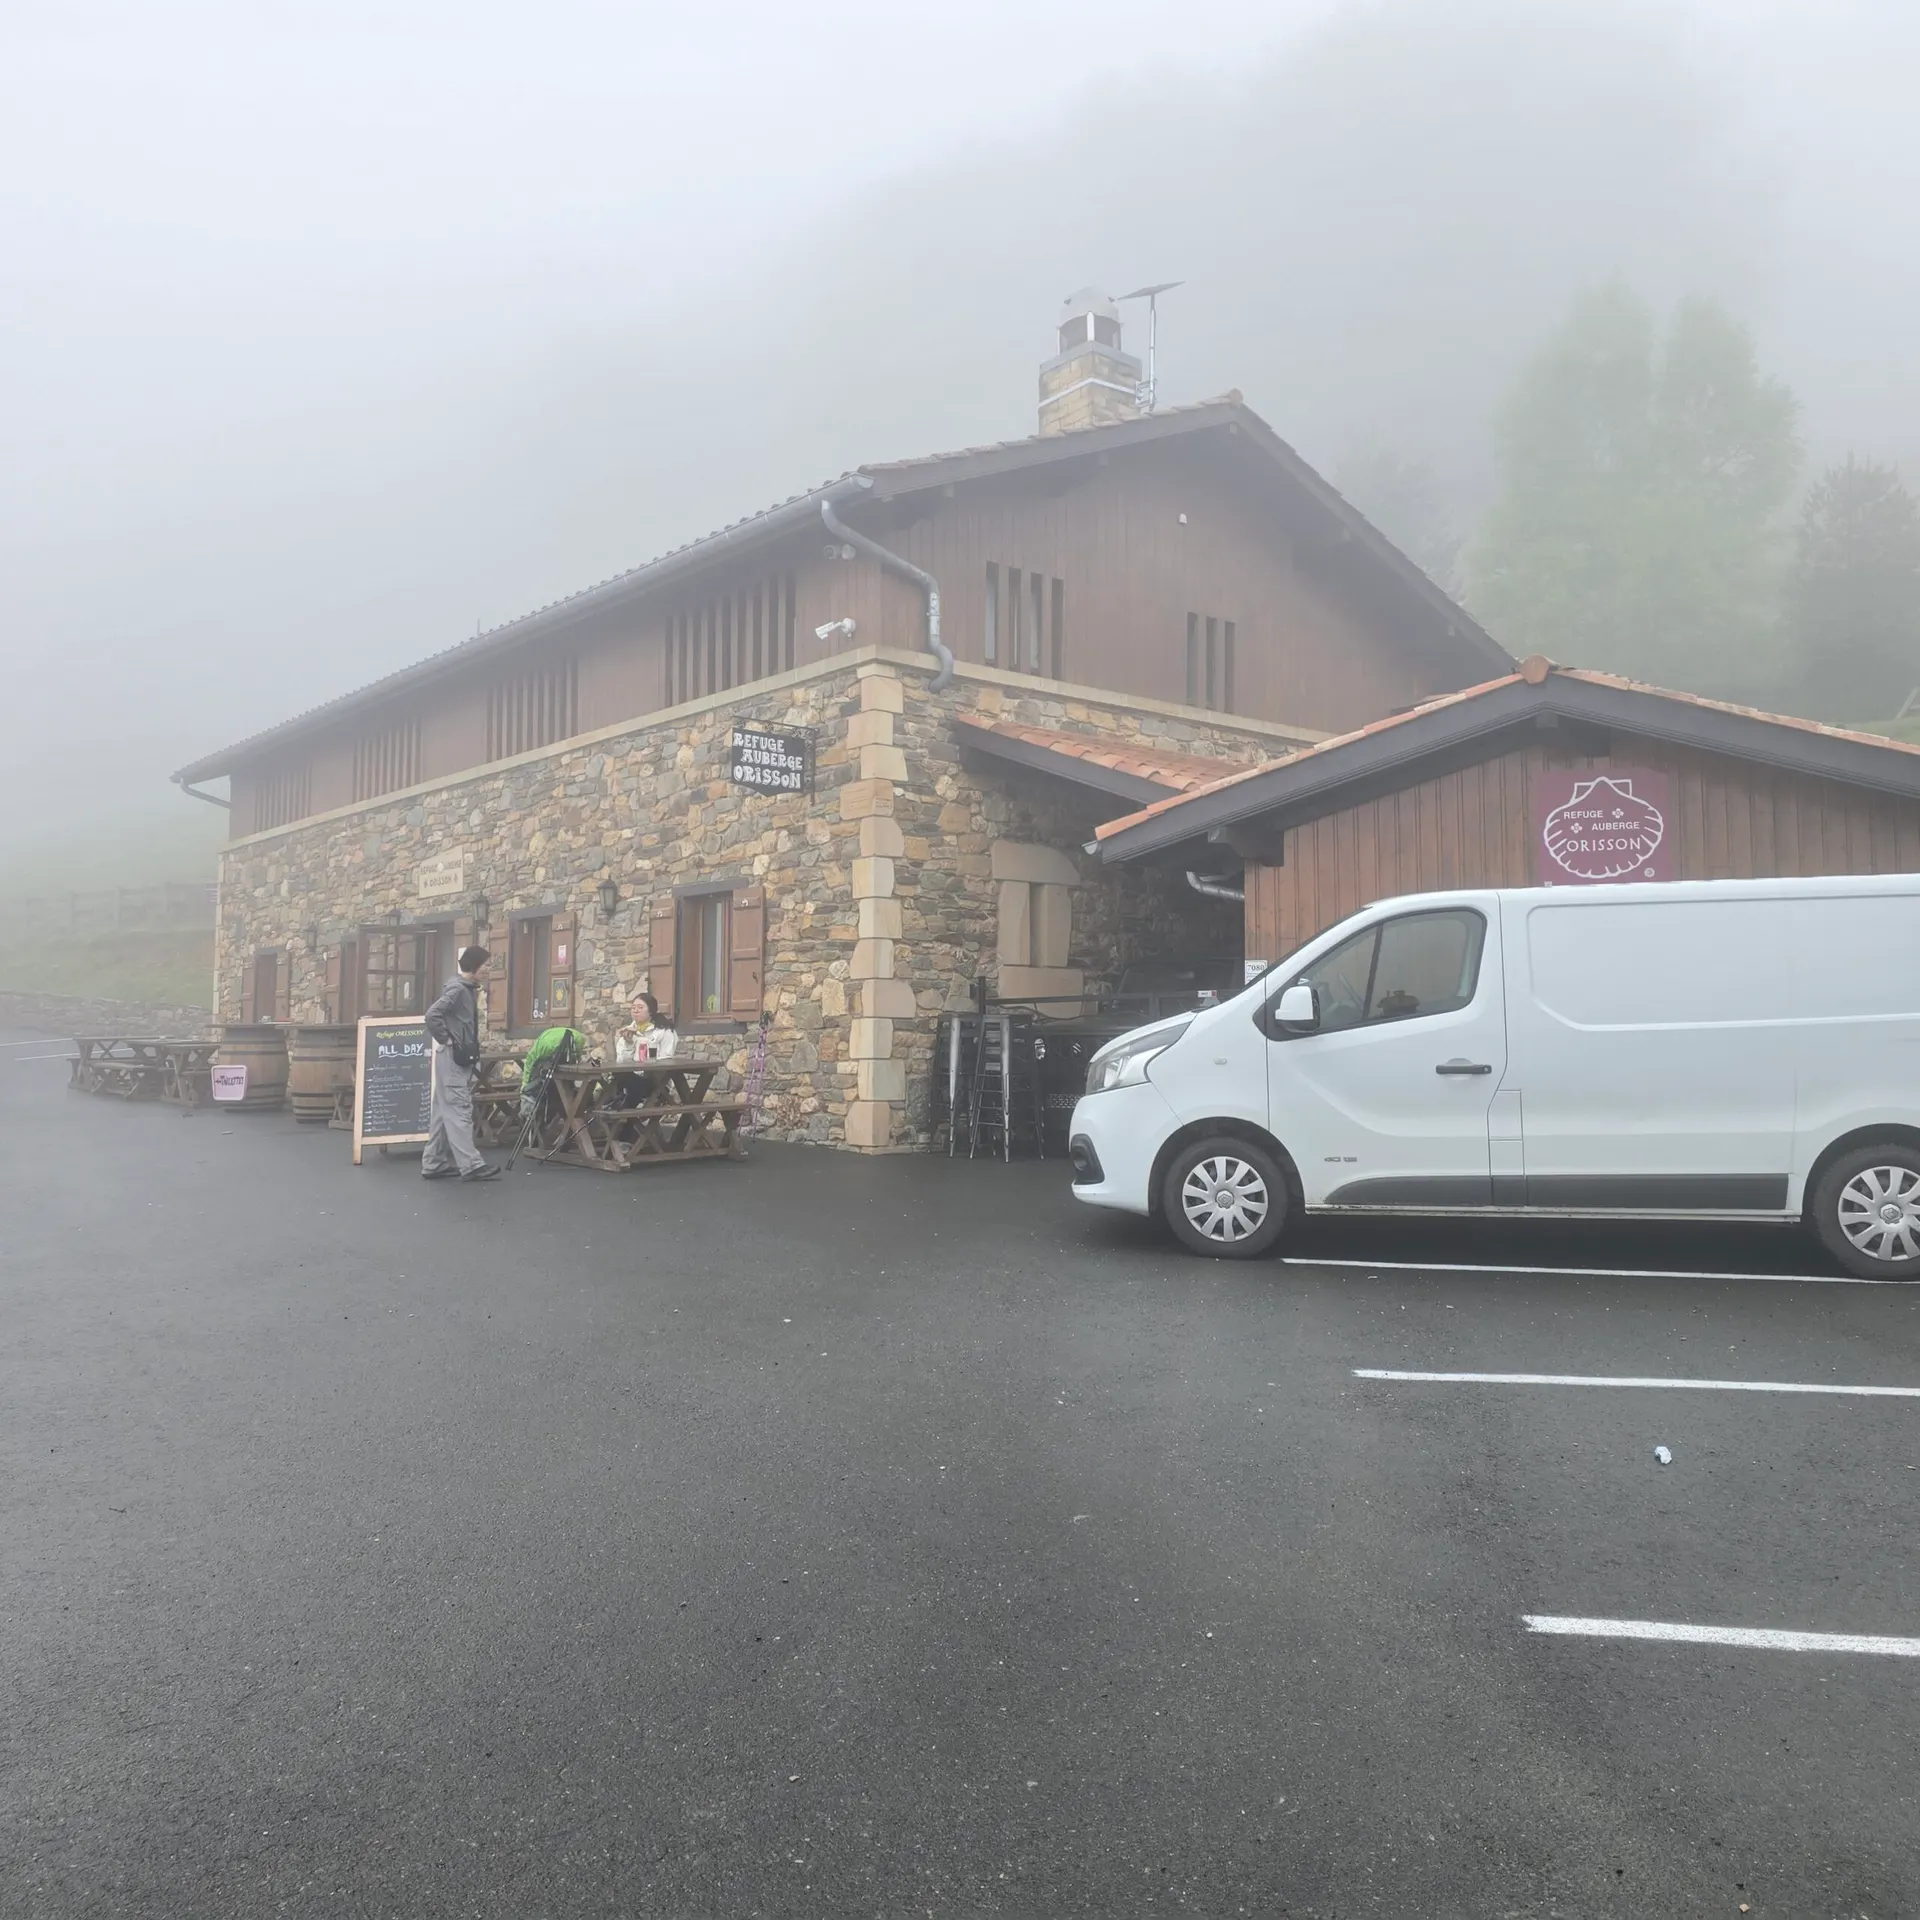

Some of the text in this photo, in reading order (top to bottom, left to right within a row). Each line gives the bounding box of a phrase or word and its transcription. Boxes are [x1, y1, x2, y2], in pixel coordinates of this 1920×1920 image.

[732, 732, 785, 753] REFUGE
[740, 748, 804, 771] AUBERGE
[1563, 810, 1604, 819] REFUGE
[1591, 821, 1640, 831] AUBERGE
[1566, 838, 1641, 852] ORISSON
[1247, 964, 1265, 972] 7080
[378, 1044, 398, 1055] ALL
[403, 1042, 424, 1054] DAY
